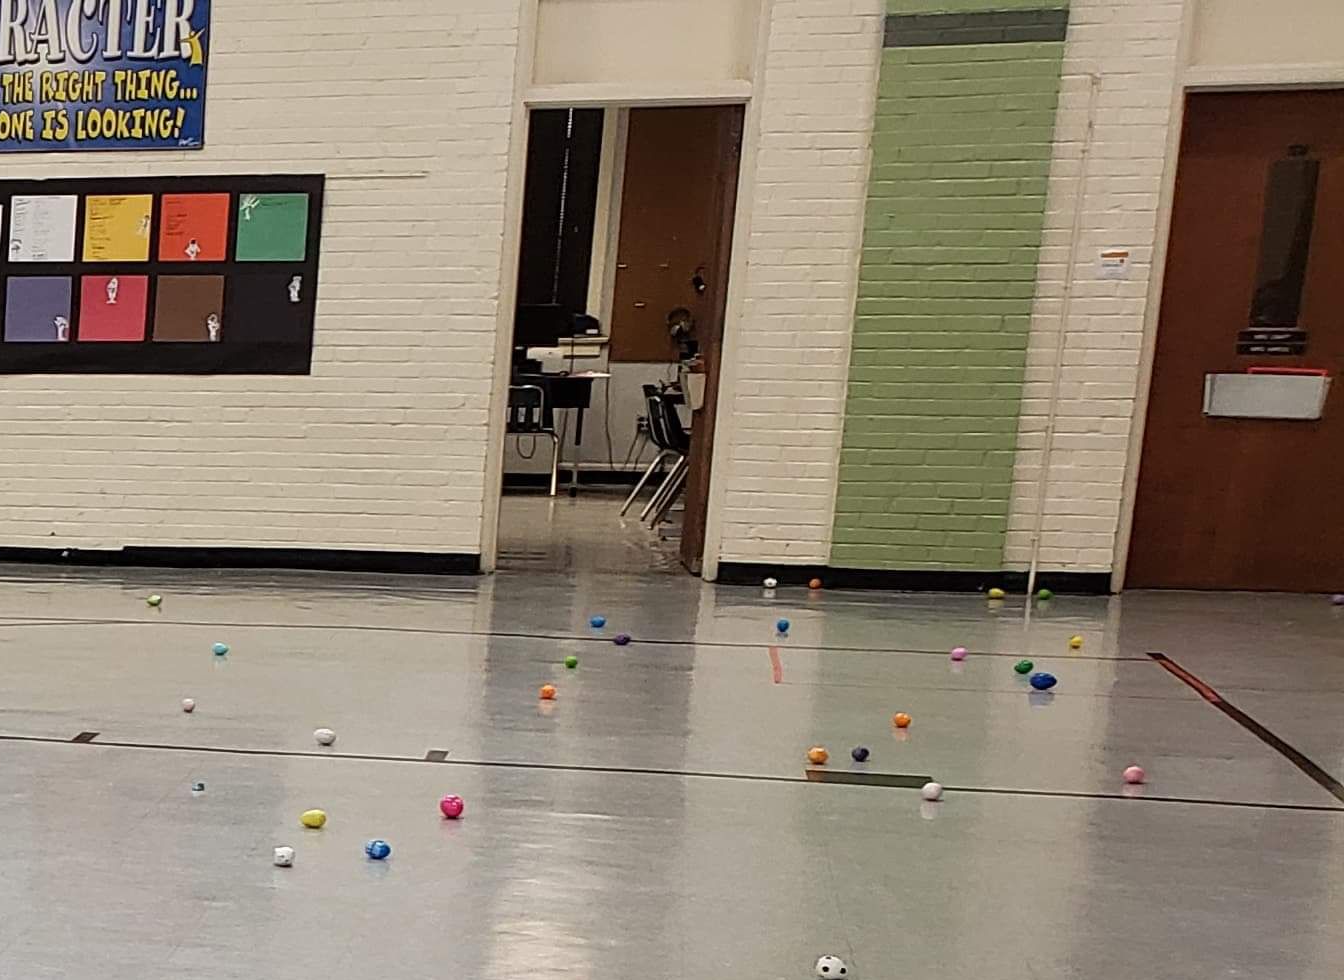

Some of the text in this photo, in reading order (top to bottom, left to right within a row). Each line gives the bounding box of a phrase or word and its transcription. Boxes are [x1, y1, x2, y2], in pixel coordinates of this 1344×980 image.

[1, 71, 34, 103] THE
[40, 70, 106, 102] RIGHT
[114, 69, 198, 101] THING...
[40, 108, 69, 140] IS
[76, 107, 185, 140] LOOKING!
